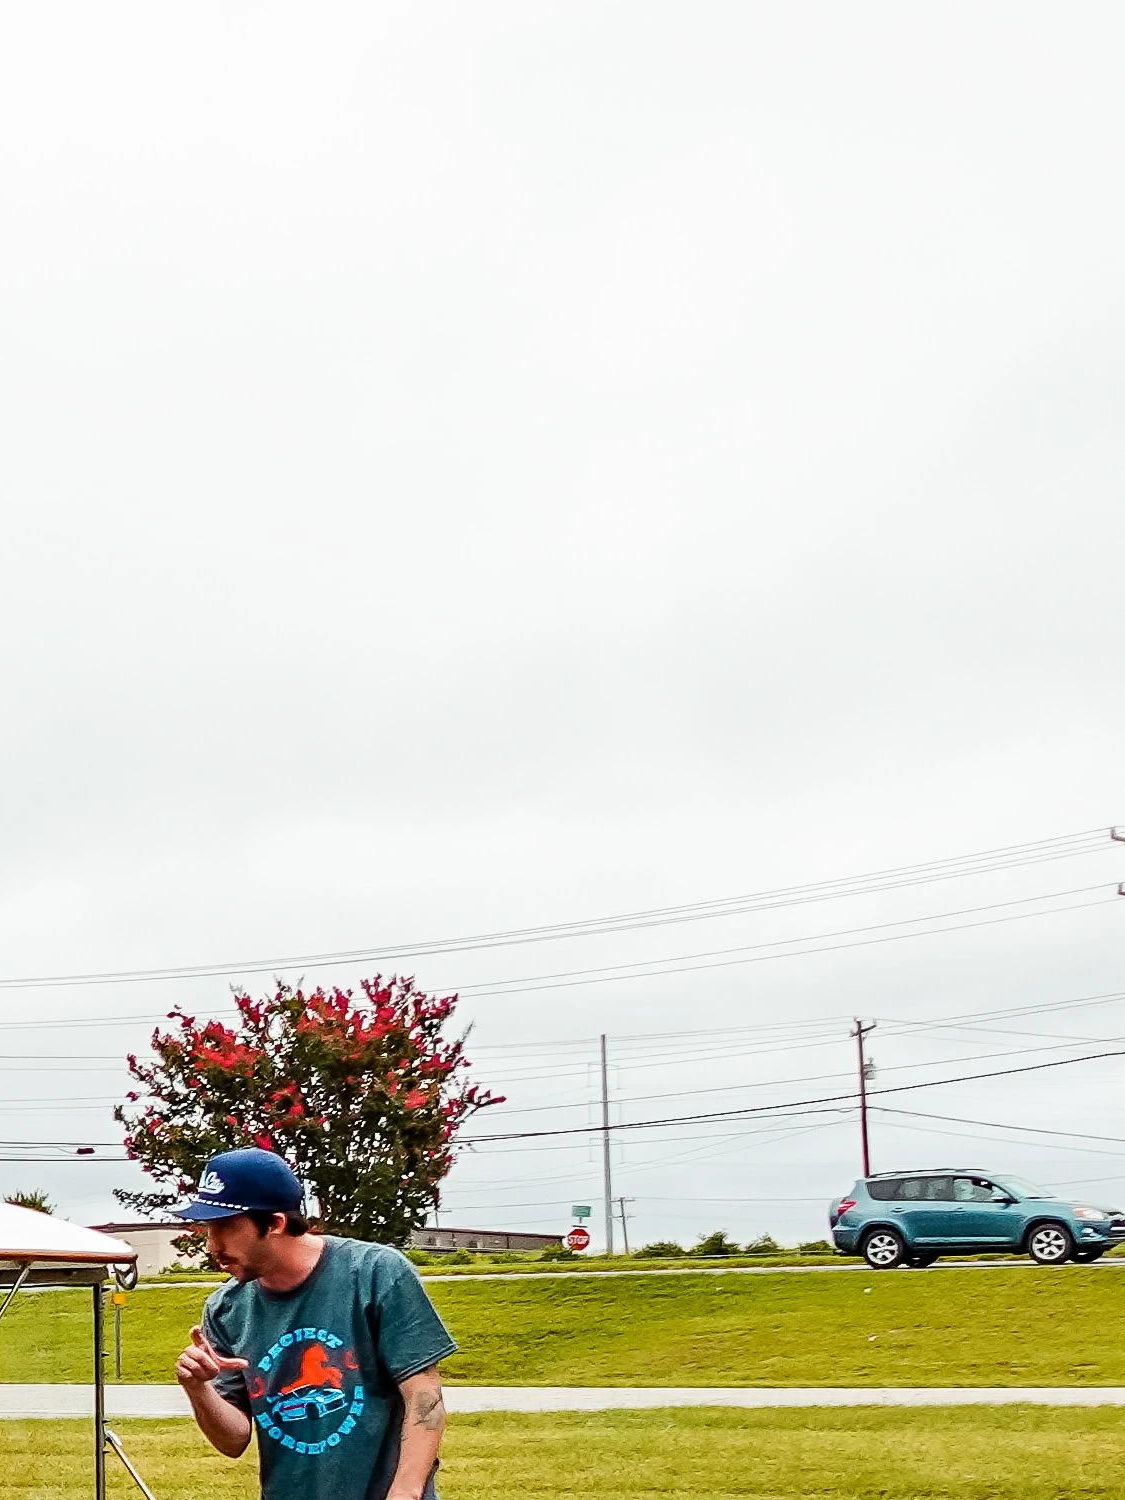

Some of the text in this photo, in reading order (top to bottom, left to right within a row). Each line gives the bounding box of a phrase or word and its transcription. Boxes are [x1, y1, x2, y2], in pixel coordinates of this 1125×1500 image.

[567, 1235, 589, 1246] STOP
[257, 1327, 343, 1372] PROJECT
[256, 1385, 364, 1454] HORSEPOWER
